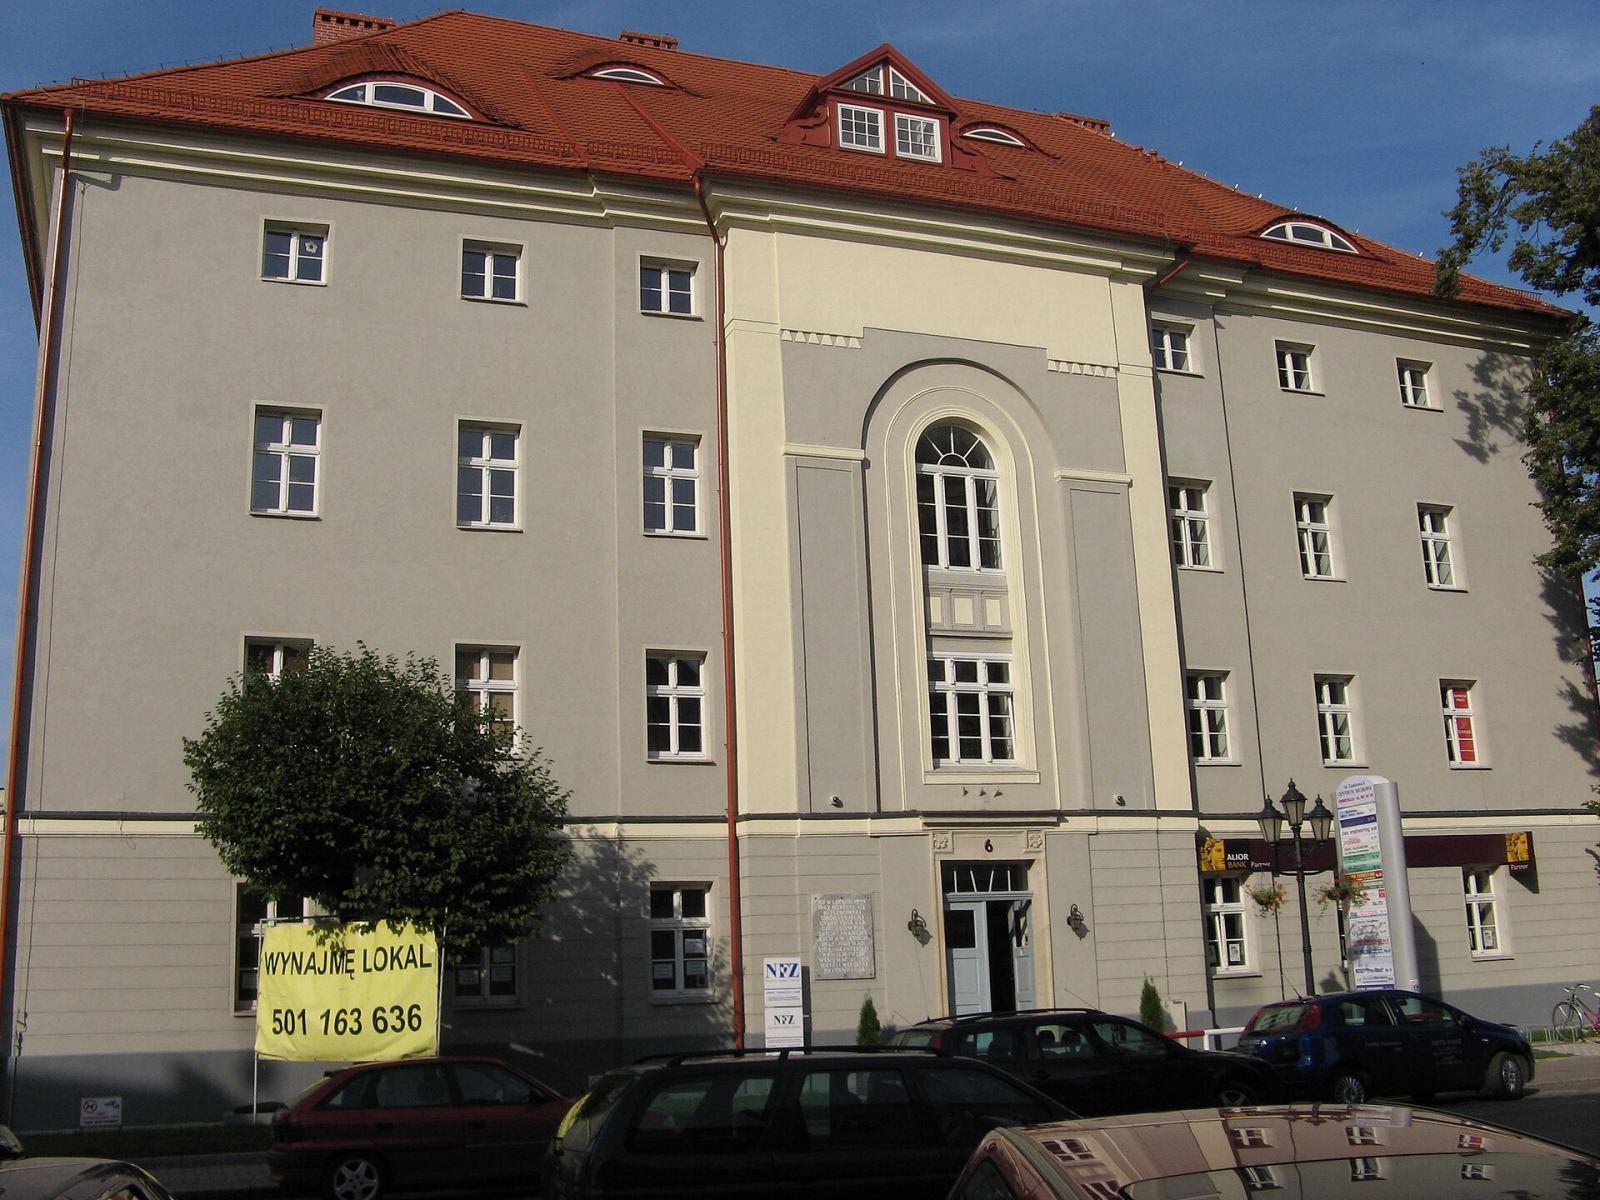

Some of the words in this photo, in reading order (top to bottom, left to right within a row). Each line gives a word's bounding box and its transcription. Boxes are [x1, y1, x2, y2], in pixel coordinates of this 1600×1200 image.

[984, 838, 994, 853] 6
[1226, 853, 1249, 861] ALIOR
[264, 949, 355, 980] WYNAJMĘ
[362, 943, 432, 973] LOKAL
[766, 963, 799, 978] NFZ
[272, 1008, 307, 1036] 501
[319, 1008, 362, 1036] 163
[372, 1004, 422, 1034] 636
[774, 1015, 795, 1025] NFZ
